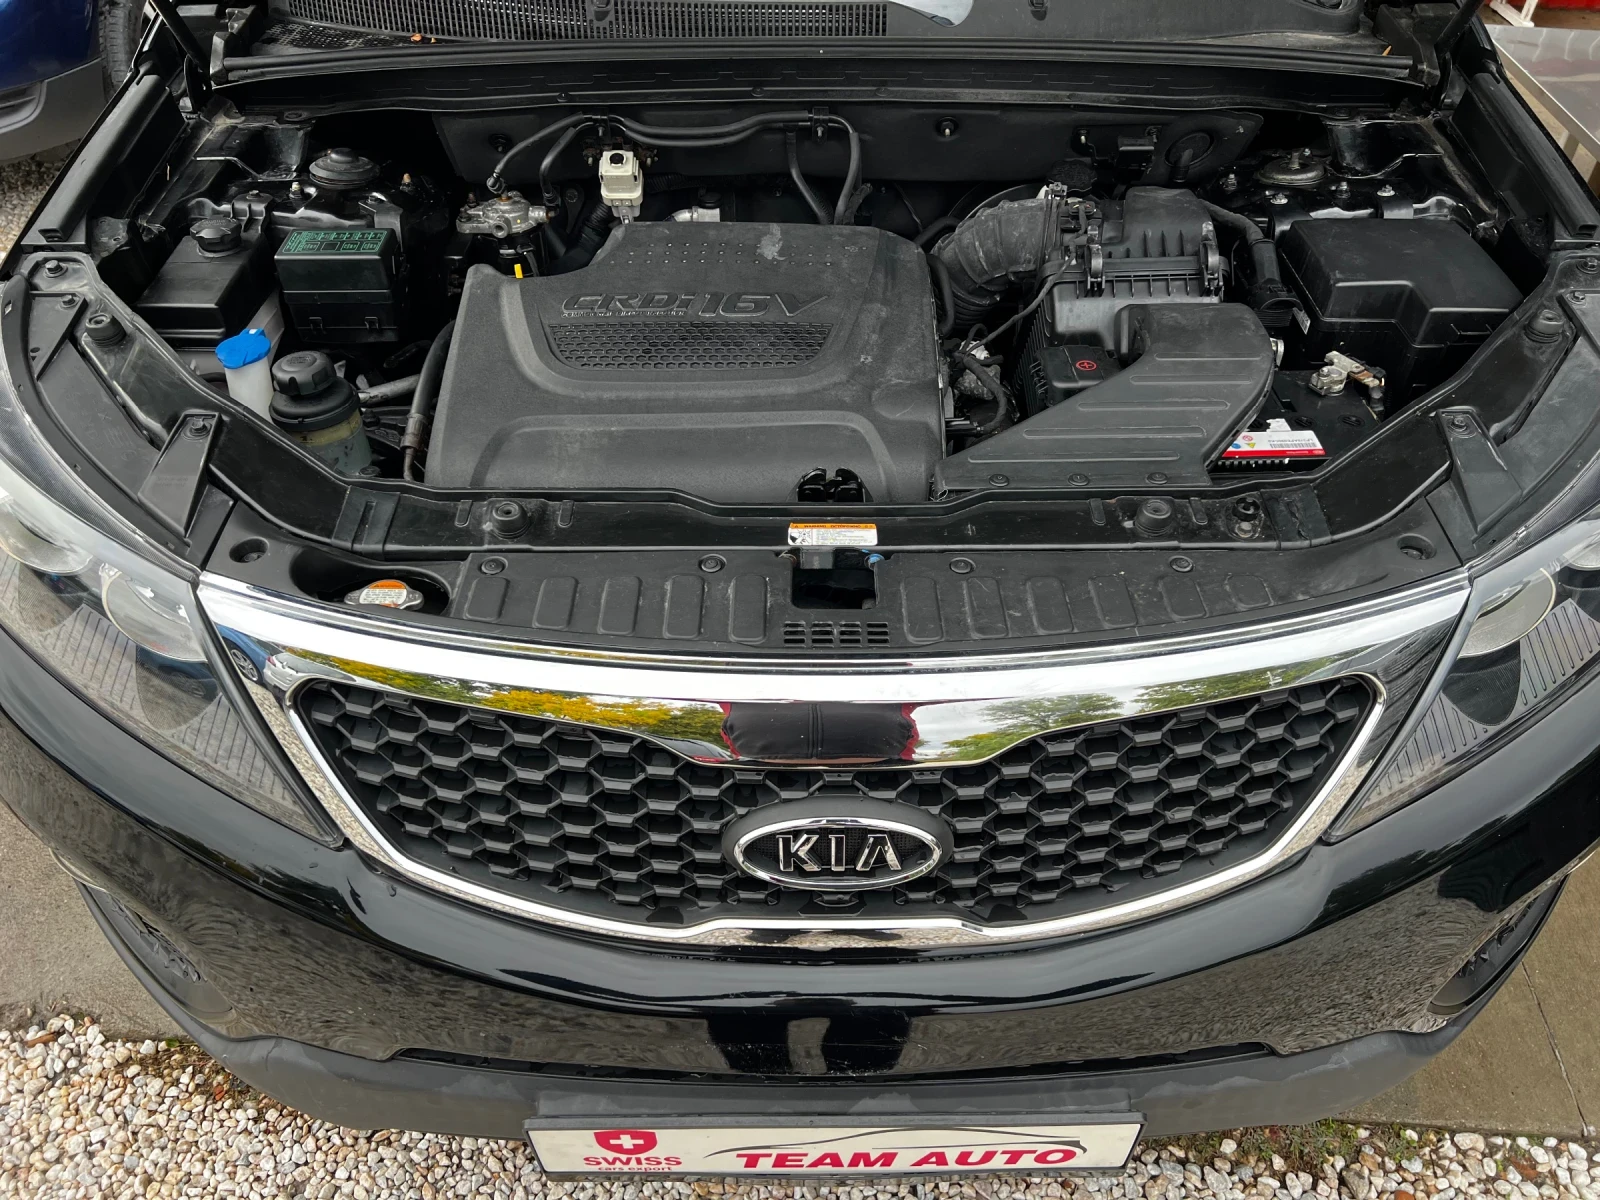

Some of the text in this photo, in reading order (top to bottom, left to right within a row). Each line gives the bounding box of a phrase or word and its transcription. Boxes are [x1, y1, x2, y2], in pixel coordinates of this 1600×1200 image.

[776, 834, 902, 872] KIA
[583, 1156, 683, 1166] SWISS
[735, 1148, 1077, 1169] TEAM AUTO
